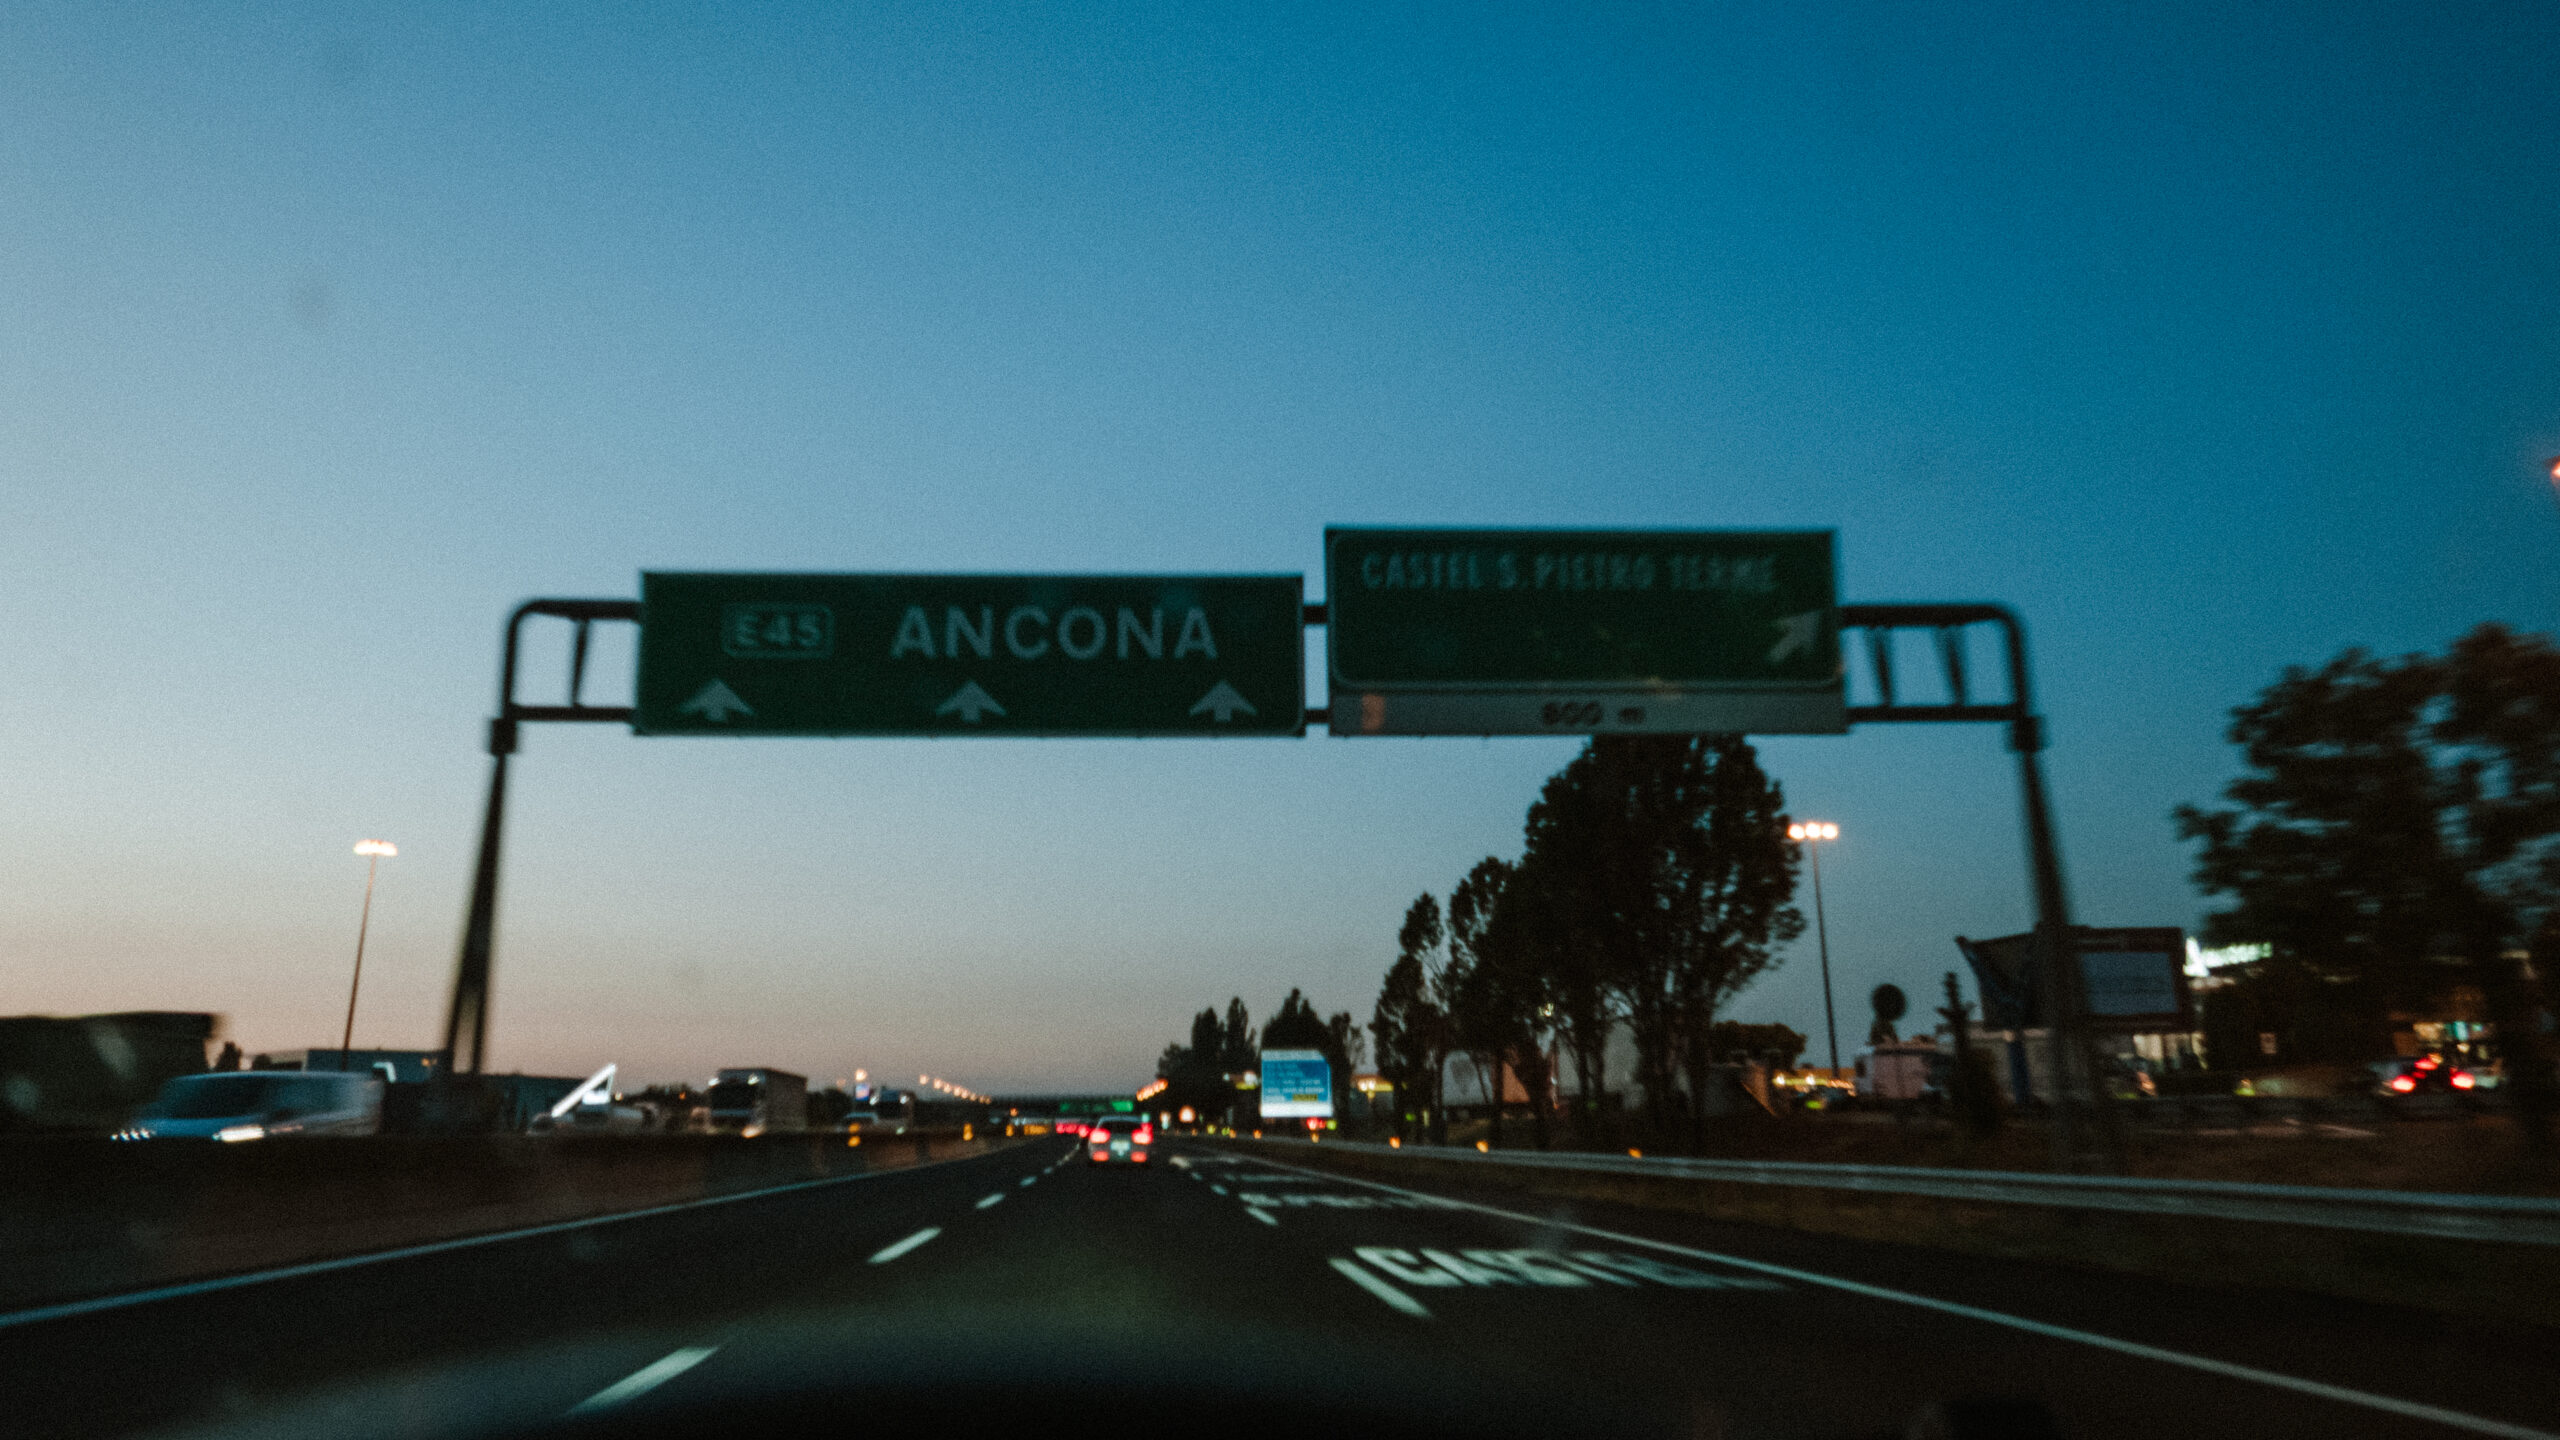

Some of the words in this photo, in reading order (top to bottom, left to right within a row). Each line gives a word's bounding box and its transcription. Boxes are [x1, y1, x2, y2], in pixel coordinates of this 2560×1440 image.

[1360, 552, 1483, 590] CASTEL
[736, 613, 823, 649] E45
[889, 605, 1220, 659] ANCONA
